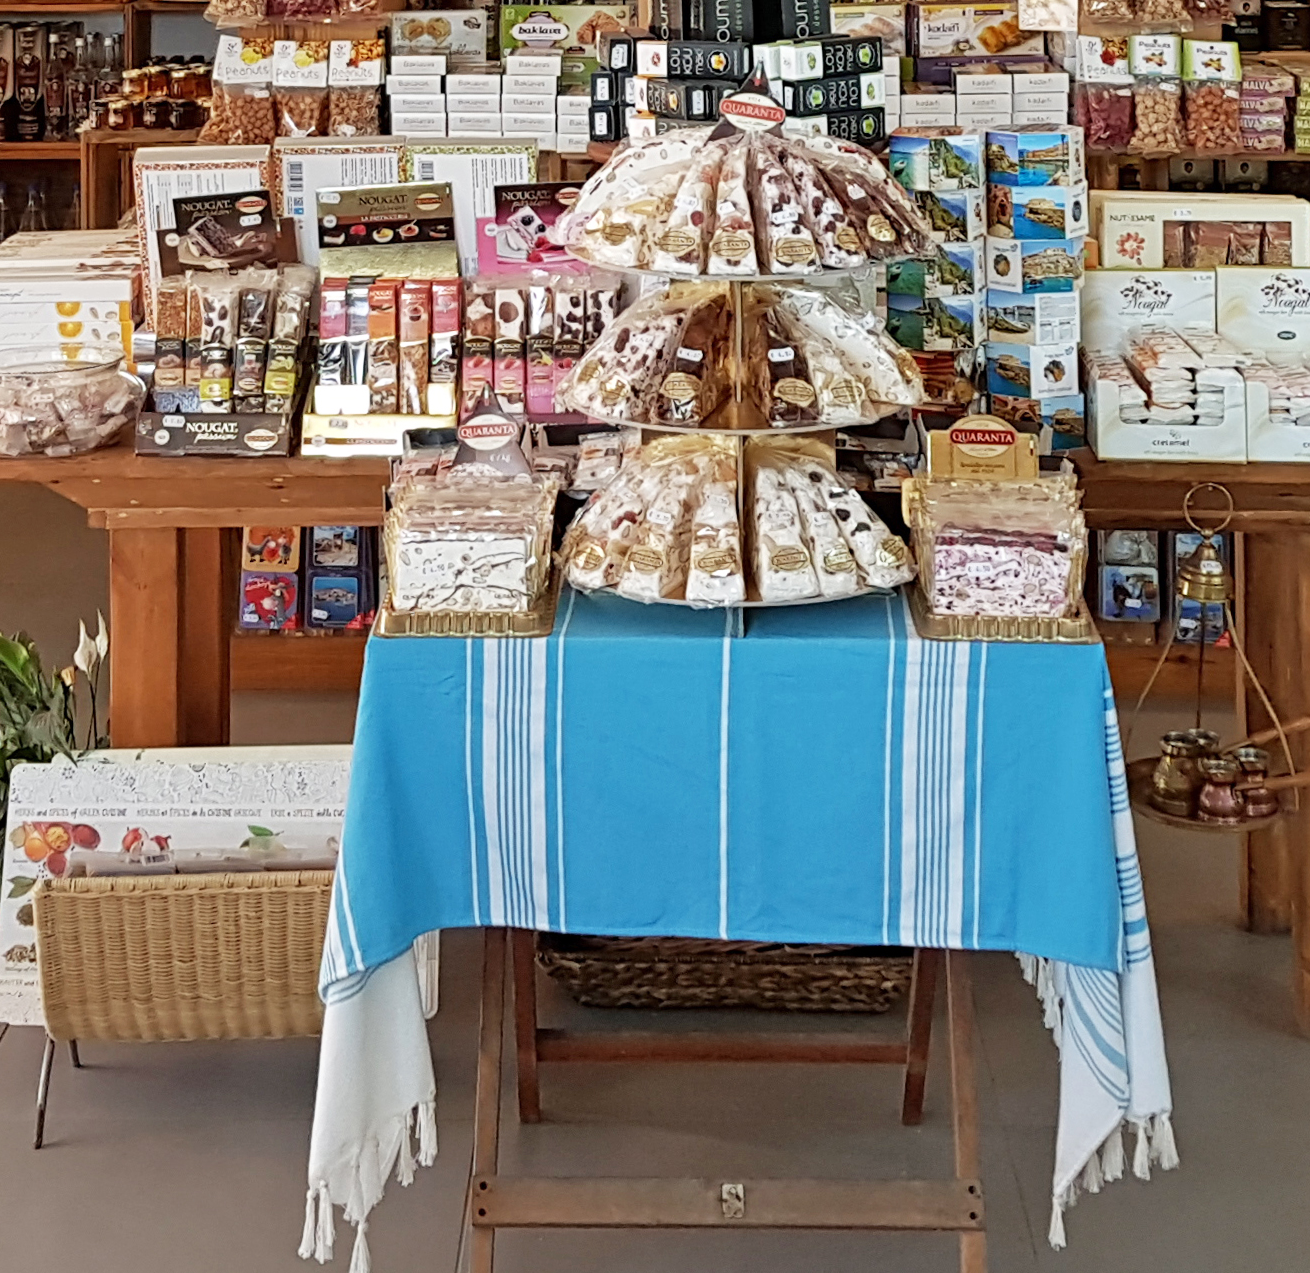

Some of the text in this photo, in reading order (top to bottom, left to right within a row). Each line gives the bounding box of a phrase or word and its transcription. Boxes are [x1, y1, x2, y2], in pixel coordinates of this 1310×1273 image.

[518, 26, 562, 36] baklava
[670, 46, 681, 75] LOU
[683, 46, 693, 75] KOU
[825, 45, 835, 73] LOU
[836, 45, 846, 72] KOU
[225, 65, 270, 77] Peanuts
[275, 68, 320, 81] Peanuts
[849, 79, 859, 106] LOU
[1243, 80, 1271, 91] HALVA
[838, 80, 848, 108] KOU
[723, 101, 782, 121] QUARANTA
[358, 194, 408, 207] NOUGAT
[501, 190, 550, 202] NOUGAT
[180, 199, 231, 212] NOUGAT
[1122, 295, 1171, 315] Nougat
[1262, 295, 1310, 315] Nougat
[186, 420, 239, 434] NOUGAT
[460, 426, 515, 439] QUARANTA
[952, 430, 1014, 444] QUARANTA
